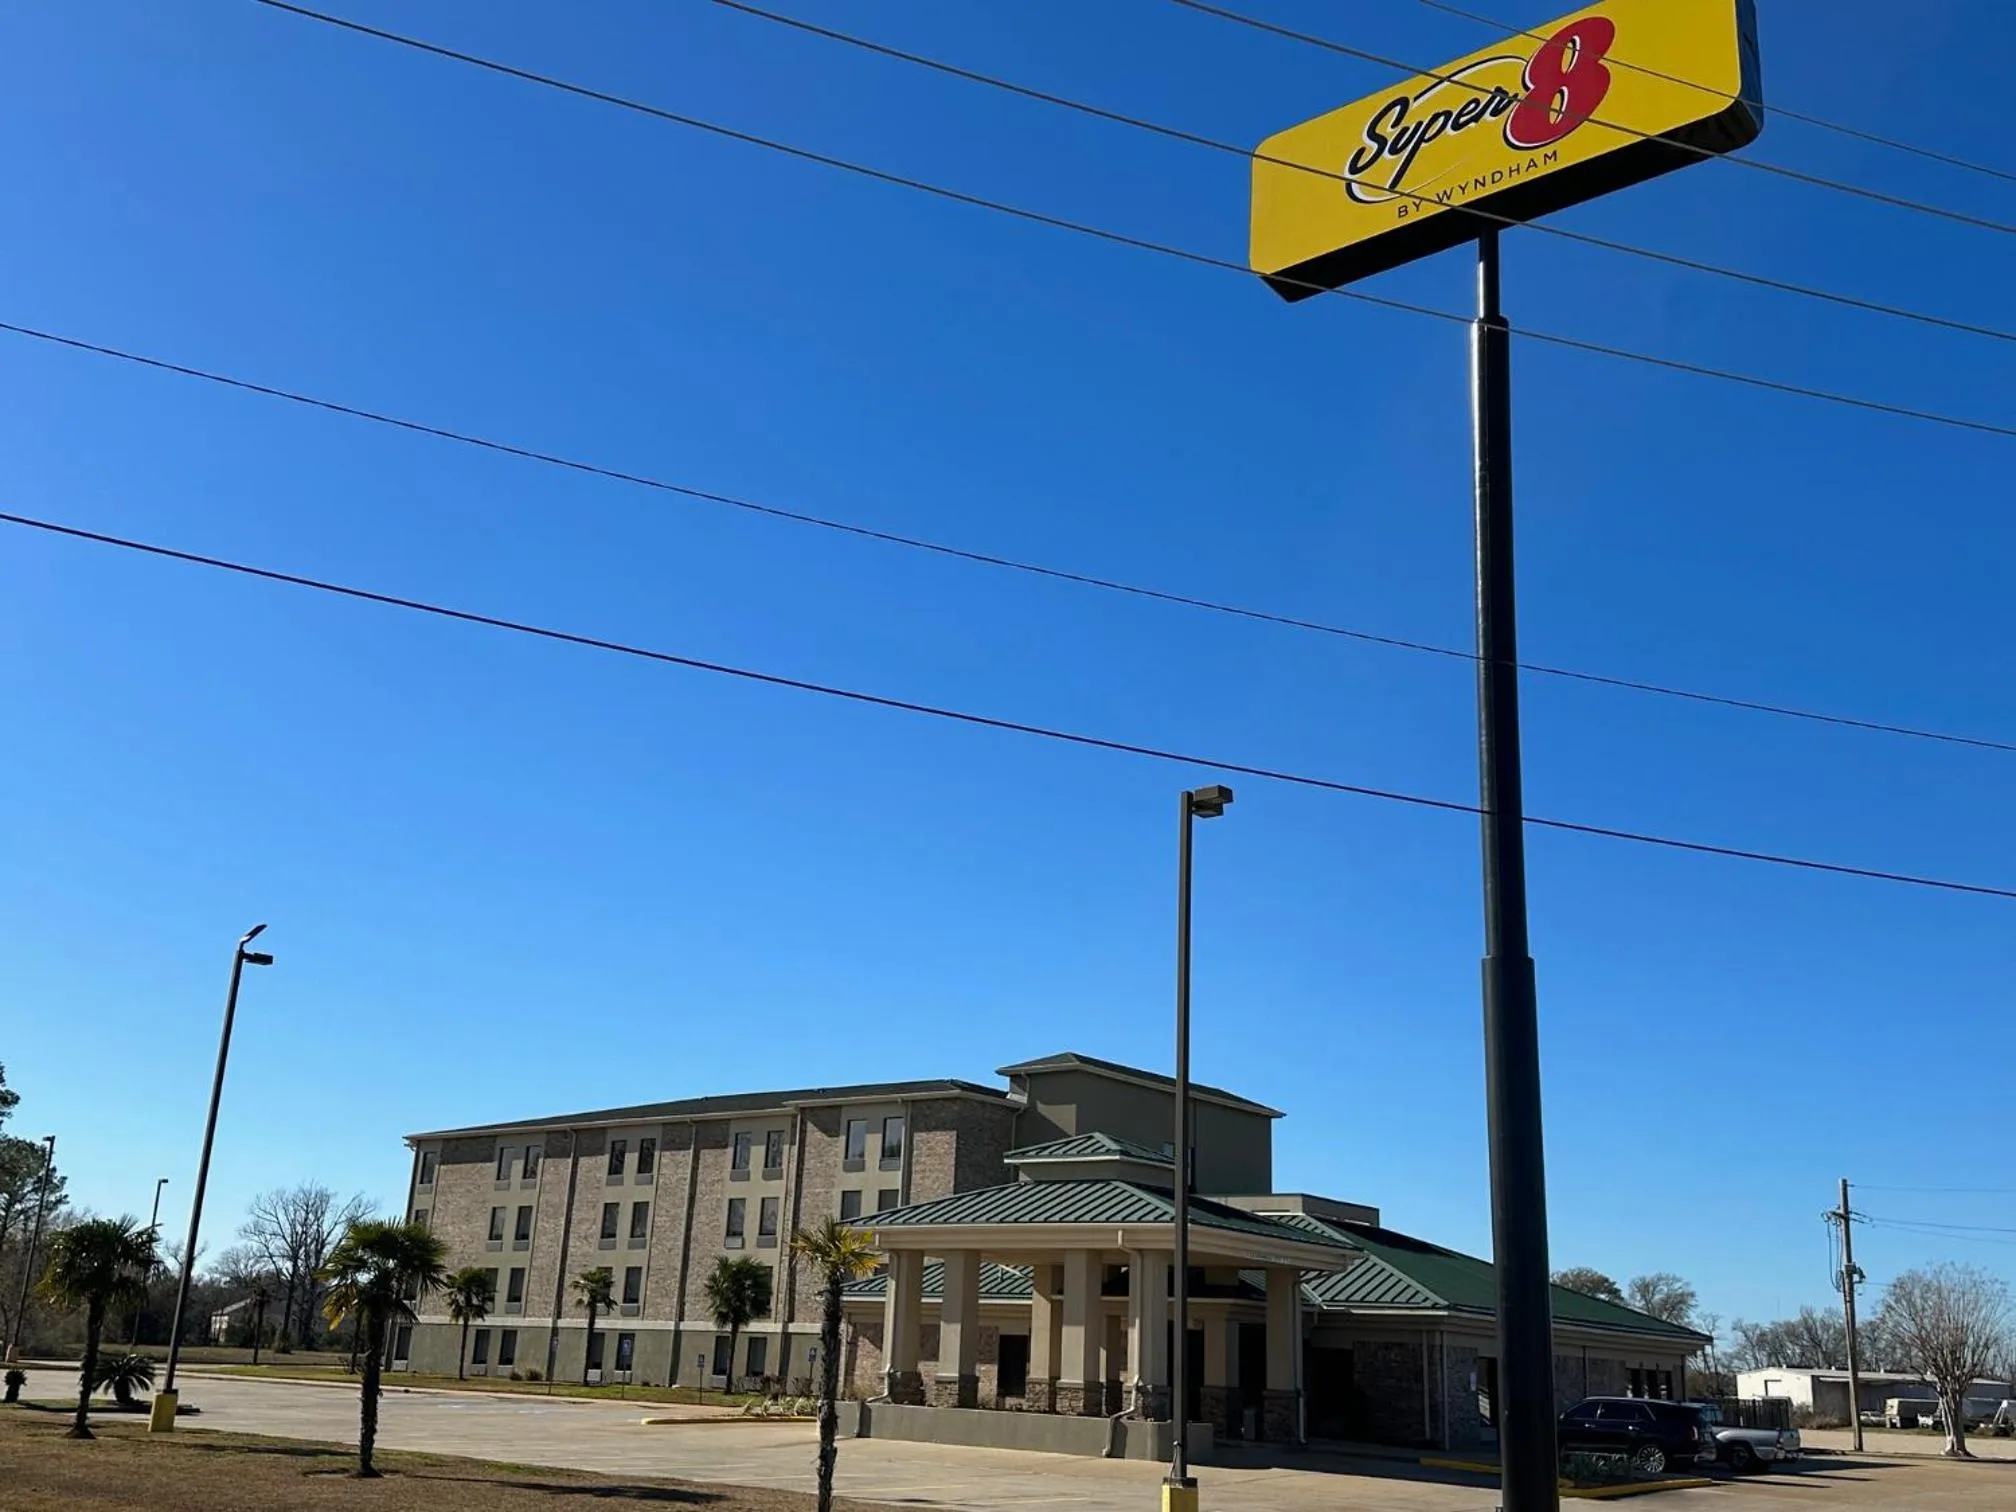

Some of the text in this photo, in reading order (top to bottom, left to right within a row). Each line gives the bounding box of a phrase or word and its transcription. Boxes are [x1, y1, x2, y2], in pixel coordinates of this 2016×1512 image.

[1346, 16, 1615, 190] Super 8
[1397, 150, 1558, 218] BY WYNDHAM
